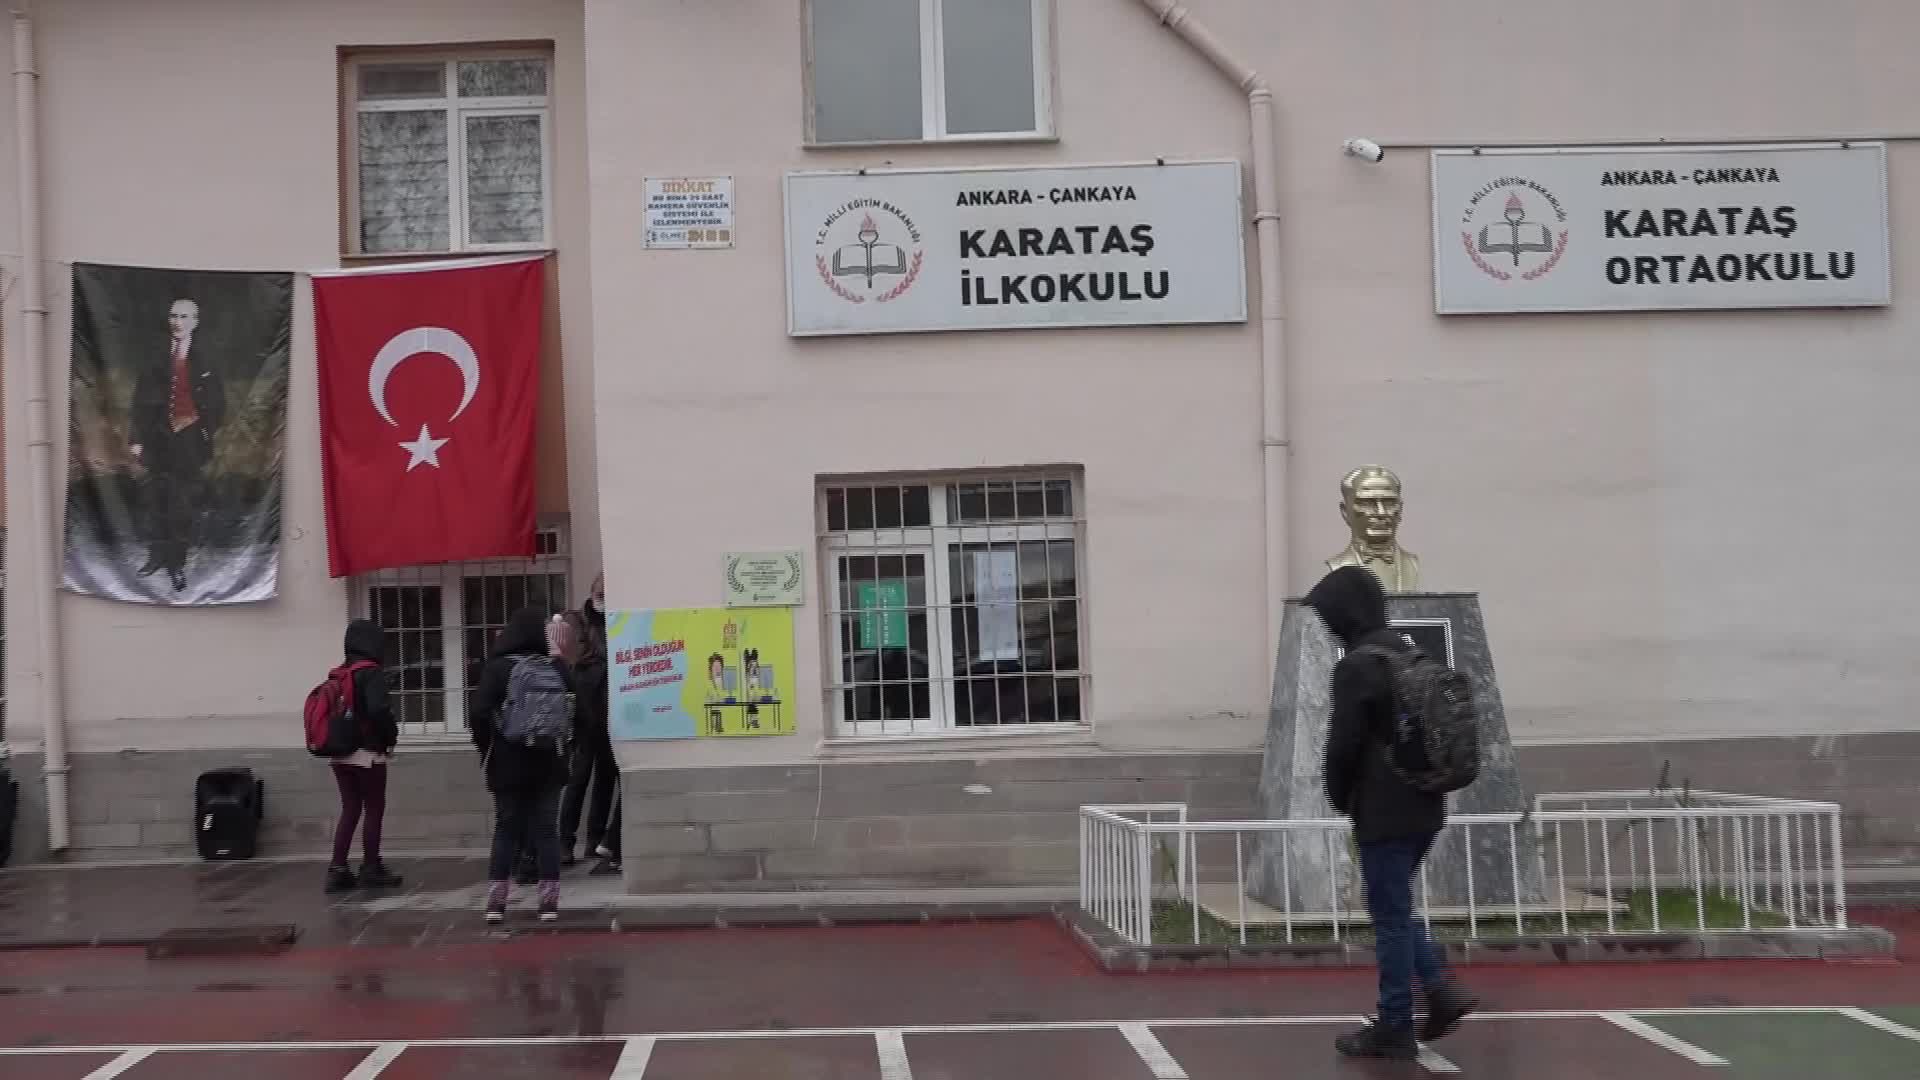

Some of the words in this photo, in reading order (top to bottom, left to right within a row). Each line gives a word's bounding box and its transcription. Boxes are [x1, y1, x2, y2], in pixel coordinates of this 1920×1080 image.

[1600, 169, 1678, 186] ANKARA
[1692, 167, 1781, 186] ÇANKAYA
[956, 190, 1032, 206] ANKARA
[1049, 185, 1137, 205] ÇANKAYA
[823, 204, 847, 228] MİLLİ
[848, 198, 880, 211] EĞİTİM
[883, 202, 921, 243] BAKANLIĞI
[1603, 206, 1798, 239] KARATAŞ
[959, 224, 1155, 258] KARATAŞ
[1605, 251, 1856, 285] ORTAOKULU
[961, 269, 1170, 306] İLKOKULU
